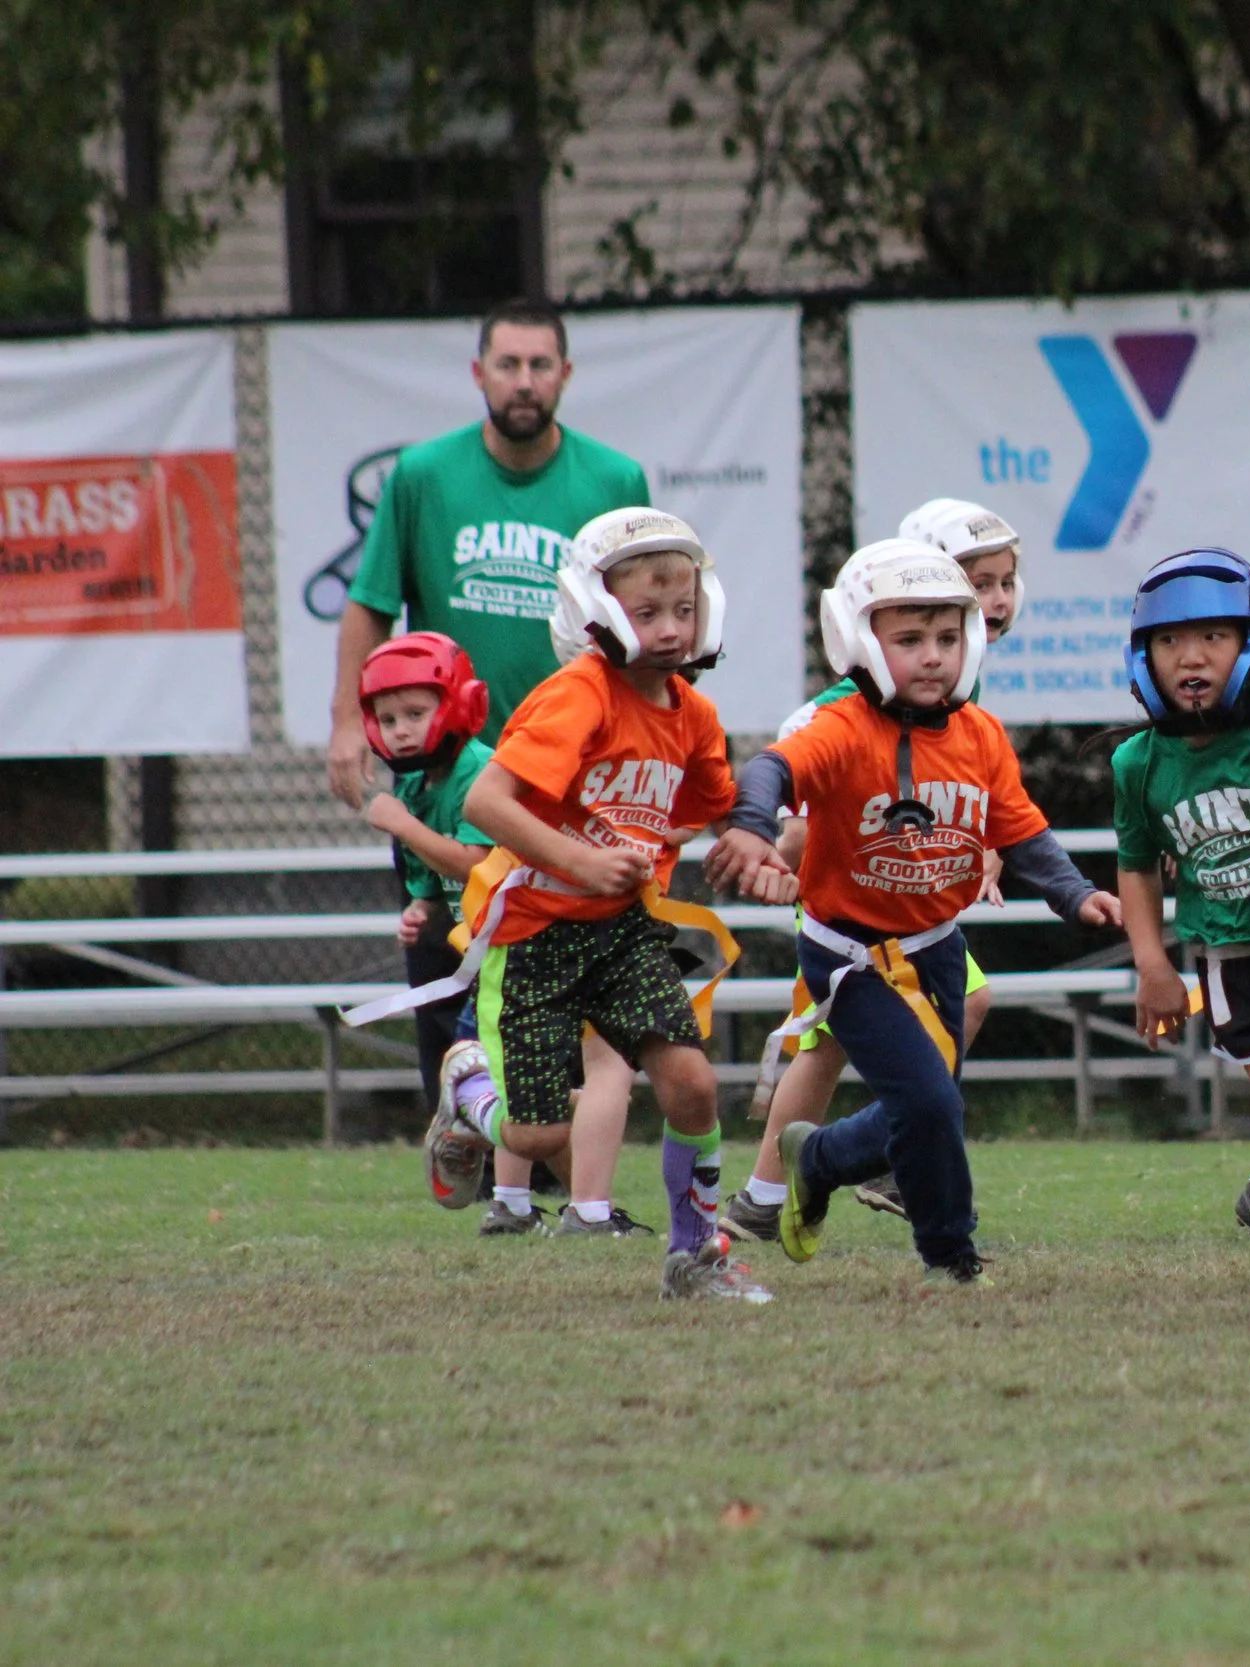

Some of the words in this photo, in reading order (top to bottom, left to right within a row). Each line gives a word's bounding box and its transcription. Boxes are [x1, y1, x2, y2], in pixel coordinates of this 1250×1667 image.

[980, 437, 1052, 483] the
[0, 480, 139, 539] RASS
[580, 758, 684, 814] SAINT
[858, 781, 989, 836] SINTS
[875, 856, 968, 880] FOOTBALL
